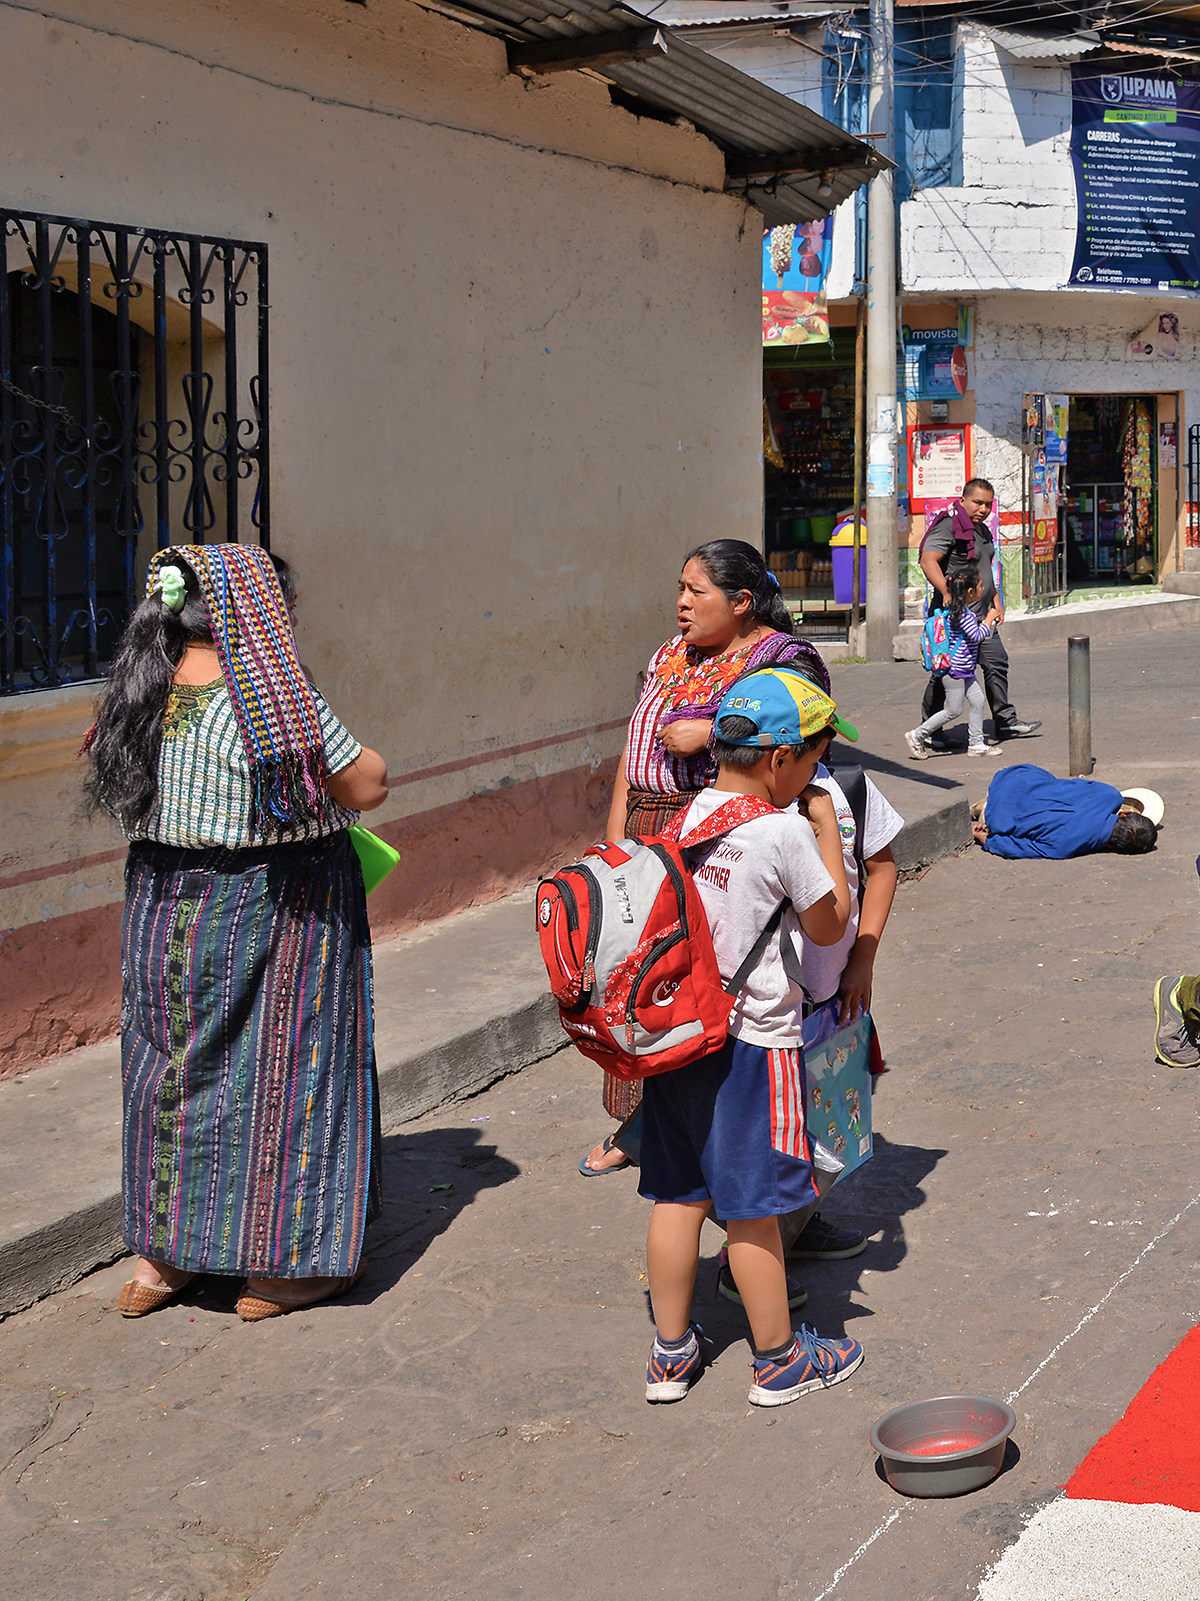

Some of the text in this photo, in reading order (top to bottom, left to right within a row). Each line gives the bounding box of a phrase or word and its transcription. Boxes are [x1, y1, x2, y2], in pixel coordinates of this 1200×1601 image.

[1123, 77, 1177, 99] UPANA
[1087, 130, 1120, 143] CARRERAS
[912, 329, 958, 339] movista
[726, 697, 761, 712] 2014
[698, 863, 731, 893] ROTHER
